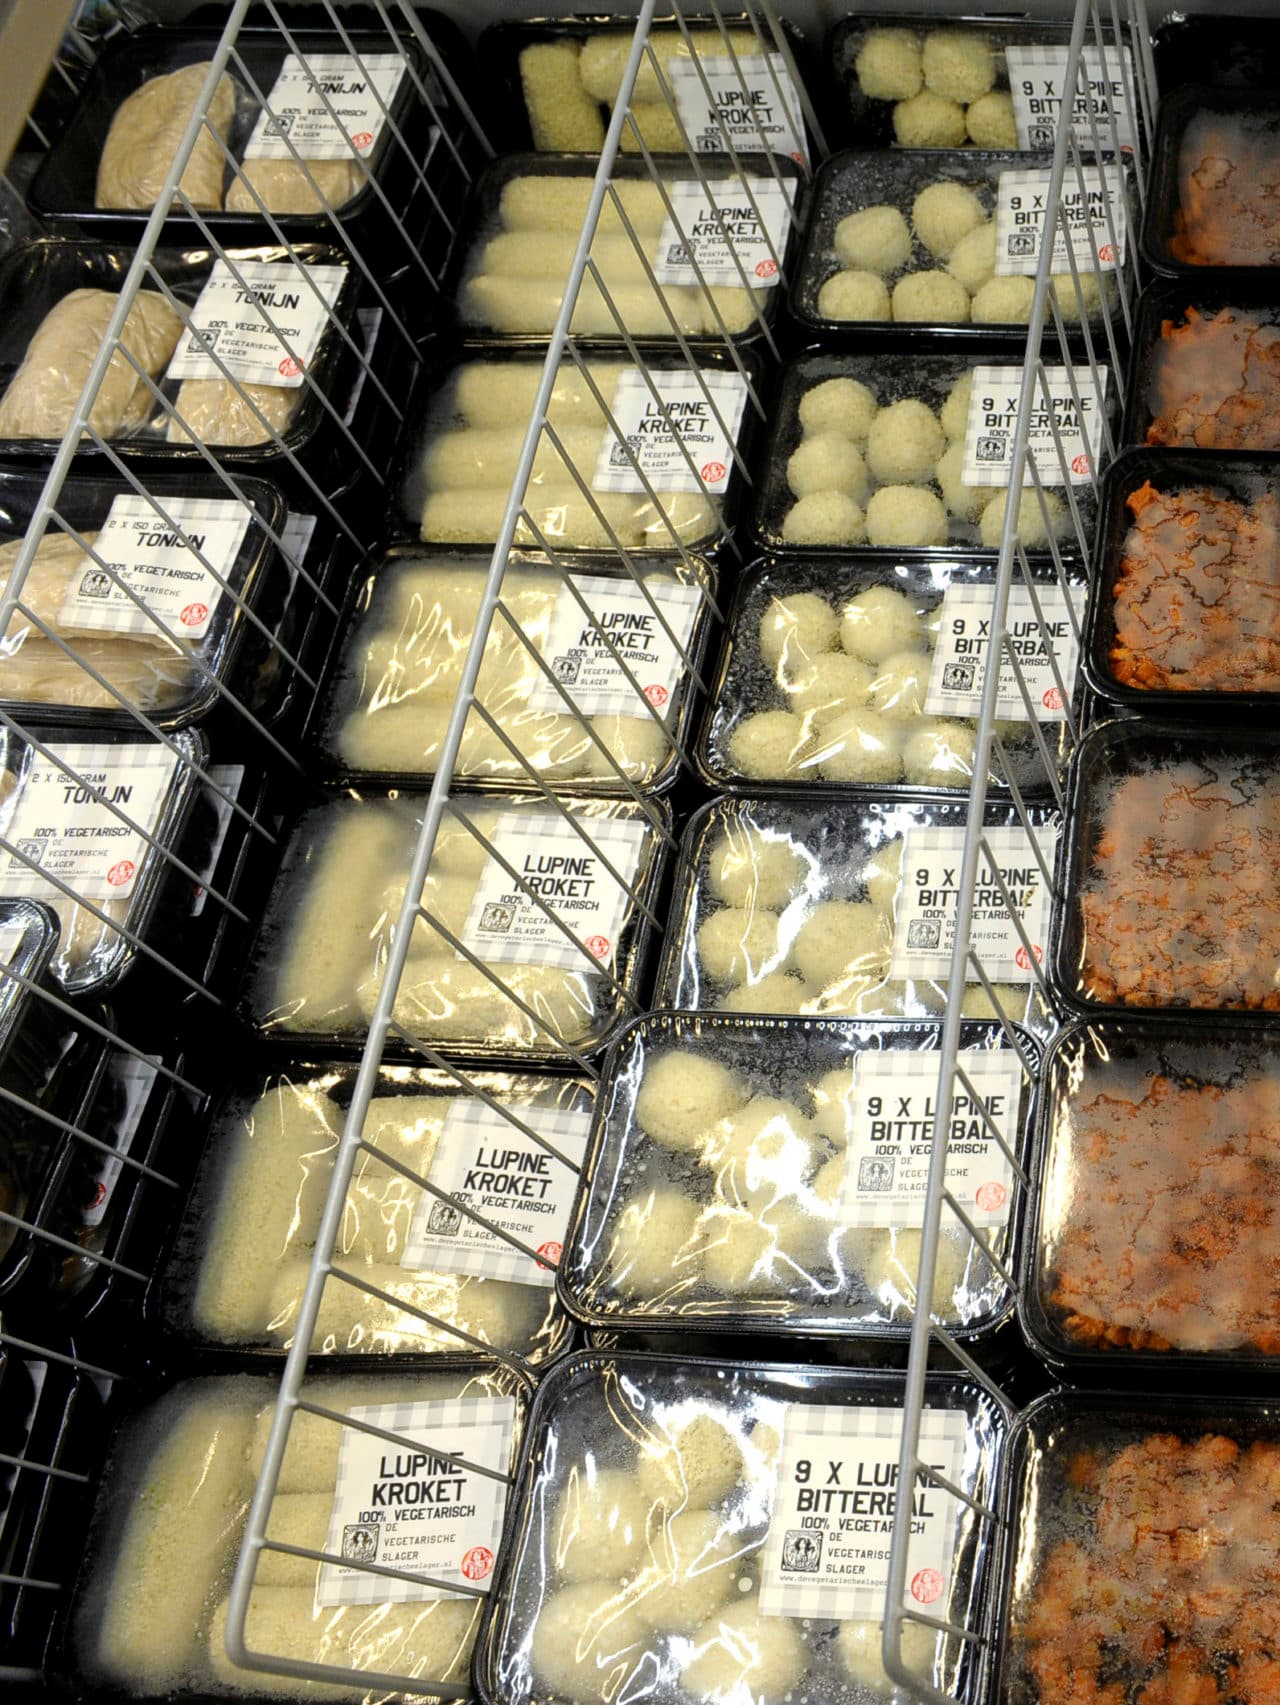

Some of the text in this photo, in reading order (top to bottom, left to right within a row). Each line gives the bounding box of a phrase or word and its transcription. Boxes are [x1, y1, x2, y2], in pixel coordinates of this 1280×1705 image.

[1022, 80, 1055, 96] 9 X
[1010, 195, 1043, 210] 9 X
[982, 398, 1017, 412] 9 X
[108, 520, 116, 528] 2
[120, 521, 127, 529] X
[133, 564, 205, 582] VEGETARISCH
[952, 619, 990, 636] 9 X
[33, 827, 132, 838] 100% VEGETARISCH
[523, 854, 595, 876] LUPINE
[915, 869, 955, 887] 9 X
[500, 894, 599, 911] 100% VGETARISCH
[867, 1096, 912, 1117] 9 X
[870, 1120, 996, 1141] BITTEBAL
[875, 1144, 902, 1156] 100%
[475, 1147, 553, 1175] LUPINE
[463, 1170, 553, 1199] KROKET
[481, 1195, 556, 1215] VEGETARISCH
[794, 1459, 946, 1489] 9 X LUPNE
[371, 1479, 467, 1506] KROKET
[358, 1505, 476, 1523] 100% VEGETARISCH
[801, 1516, 831, 1530] 100%
[384, 1534, 456, 1547] VEGETARISCHE
[382, 1551, 419, 1562] SLAGER
[825, 1564, 866, 1575] SLAGER
